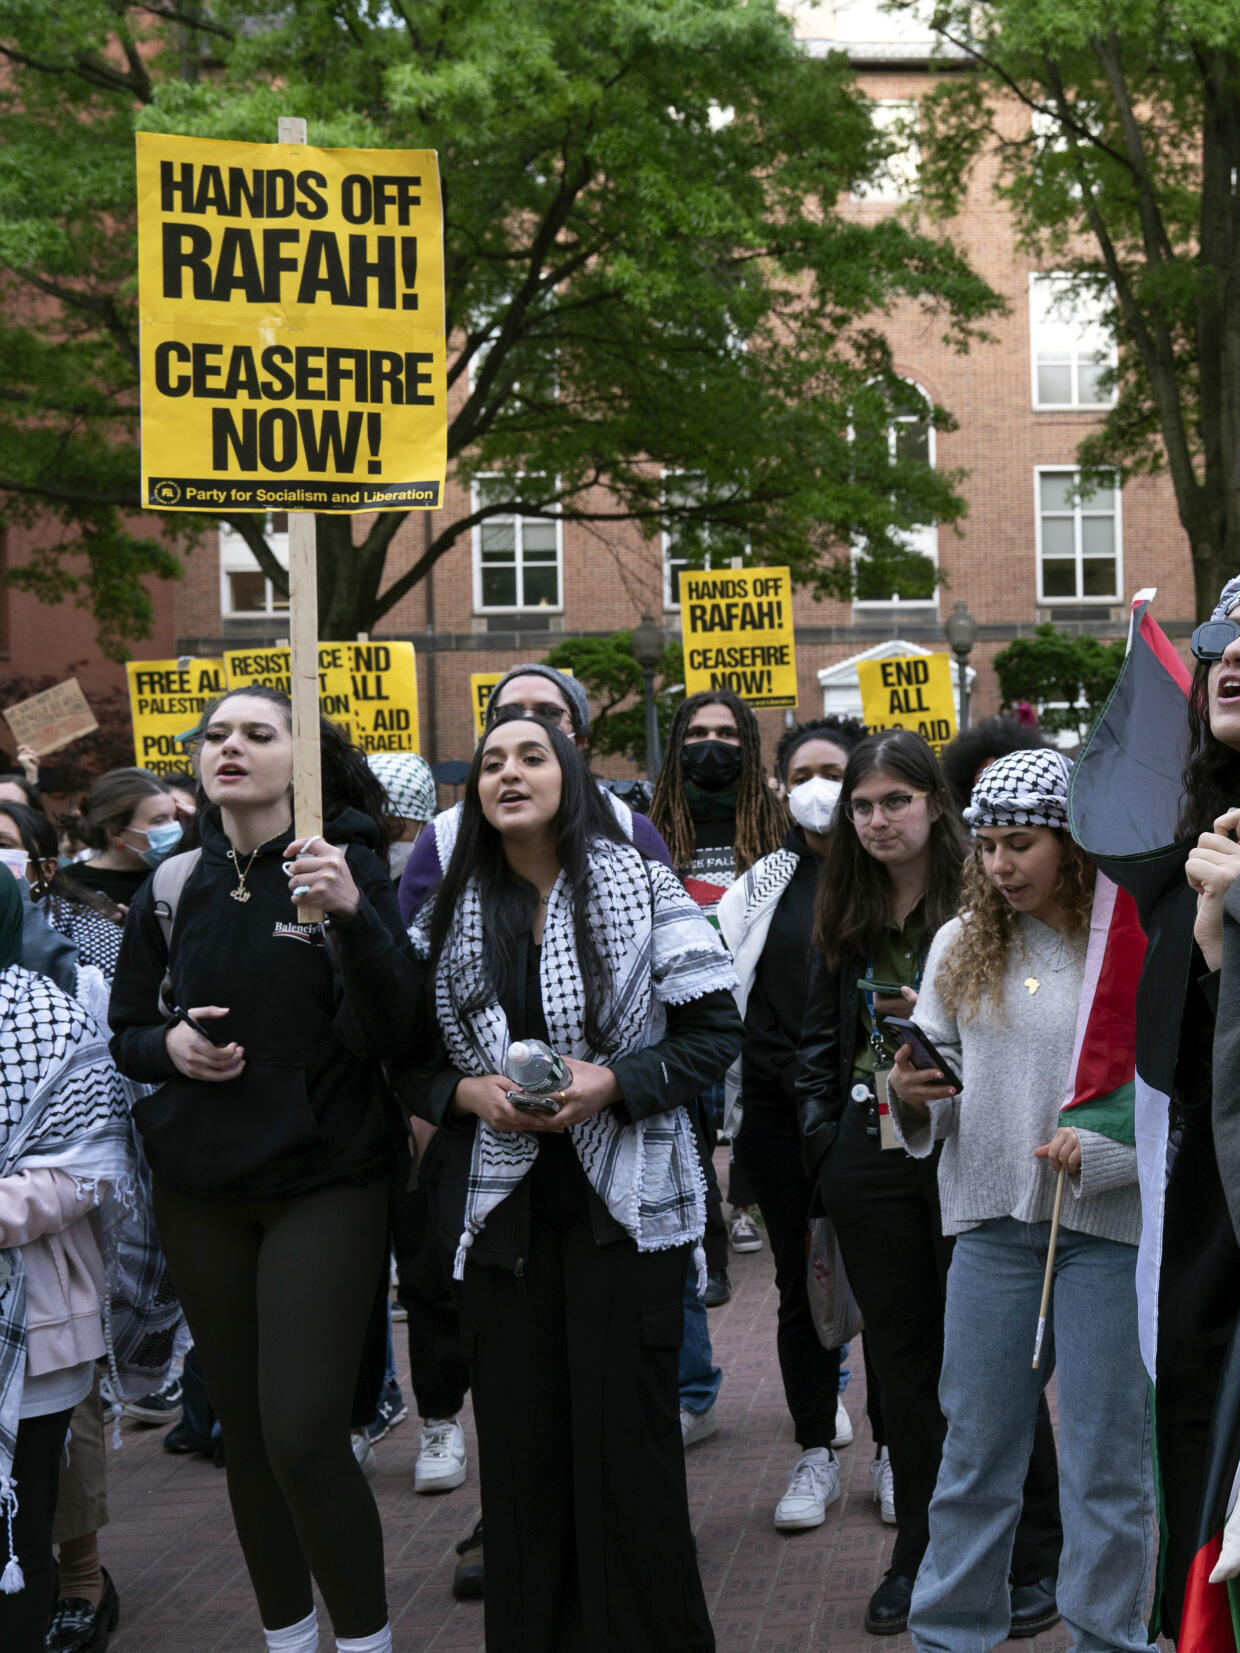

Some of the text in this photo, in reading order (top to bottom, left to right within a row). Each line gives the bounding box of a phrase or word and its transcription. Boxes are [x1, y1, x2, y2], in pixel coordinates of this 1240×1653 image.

[160, 160, 421, 226] HANDS OFF
[161, 222, 419, 311] RAFAH!
[155, 340, 435, 406] CEASEFIRE
[211, 407, 382, 475] NOW!
[186, 487, 433, 503] Party for Socialism and Liberation
[688, 577, 783, 600] HANDS OFF
[690, 601, 783, 633] RAFAH!
[689, 645, 790, 670] CEASEFIRE
[136, 669, 228, 695] FREE AL
[711, 669, 773, 695] NOW!
[881, 660, 929, 688] END
[889, 687, 930, 715] ALL
[373, 709, 410, 732] AID
[918, 719, 951, 742] AID
